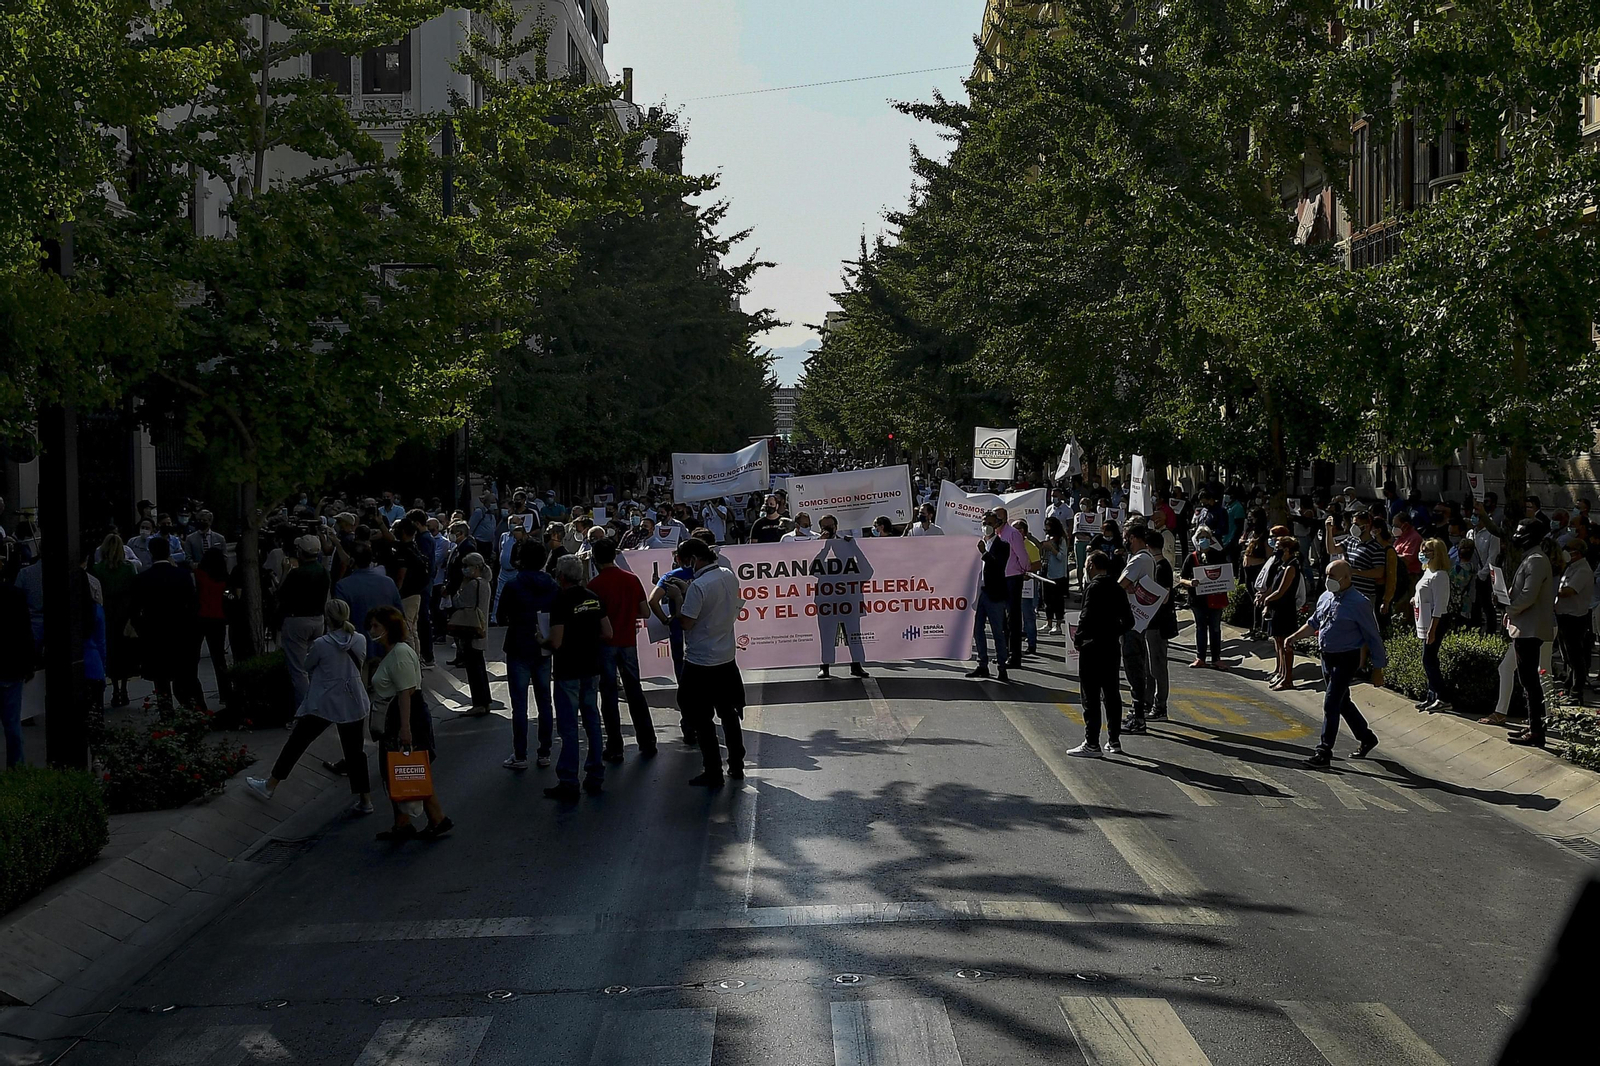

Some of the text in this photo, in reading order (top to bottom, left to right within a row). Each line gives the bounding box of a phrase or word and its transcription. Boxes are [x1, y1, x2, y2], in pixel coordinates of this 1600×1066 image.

[707, 472, 725, 480] OCIO
[726, 460, 763, 477] NOCTURNO
[799, 498, 829, 508] SOMOS
[830, 496, 852, 504] OCIO
[854, 490, 901, 501] NOCTURNO
[957, 503, 985, 514] SOMOS
[738, 557, 860, 580] GRANADA
[775, 584, 800, 598] LA
[806, 576, 934, 597] HOSTELERÍA,
[756, 606, 768, 619] Y
[775, 604, 798, 618] EL
[804, 602, 852, 616] OCIO
[859, 597, 968, 614] NOCTURNO
